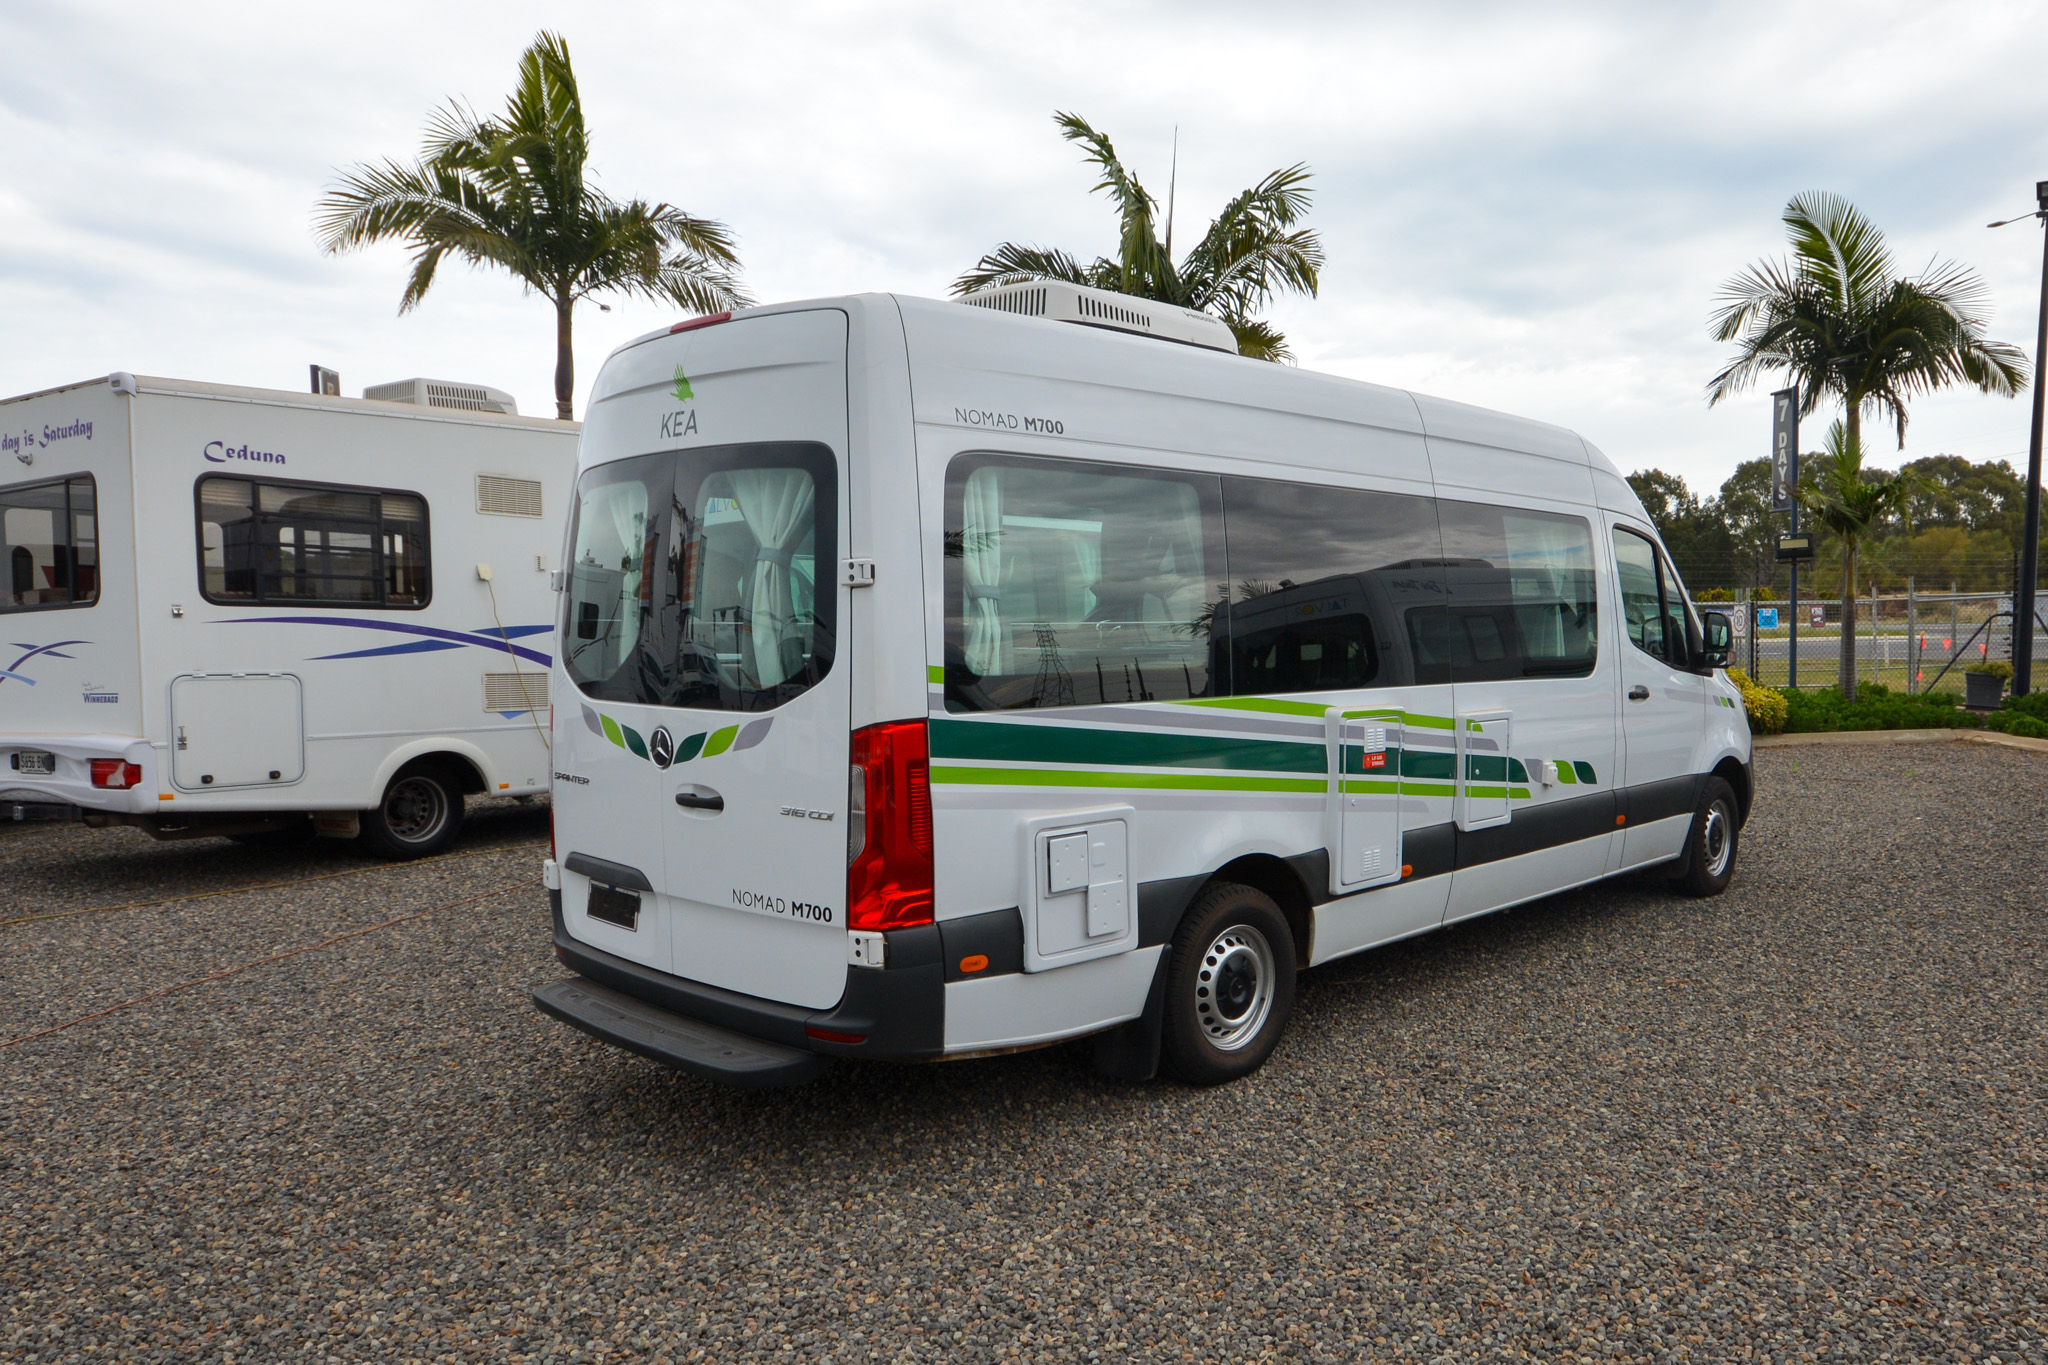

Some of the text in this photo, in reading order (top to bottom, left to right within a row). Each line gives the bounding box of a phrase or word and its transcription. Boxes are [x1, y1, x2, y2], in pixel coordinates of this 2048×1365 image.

[660, 409, 698, 439] KEA
[955, 407, 1064, 434] NOMAD M700
[1, 418, 93, 454] day is Saturday
[1778, 399, 1789, 500] 7 DAYS
[203, 440, 286, 465] Ceduna
[82, 693, 119, 703] WINNEBAGO
[554, 771, 590, 785] SPRINTER
[780, 805, 835, 821] 316 CDI
[732, 888, 832, 922] NOMAD M700
